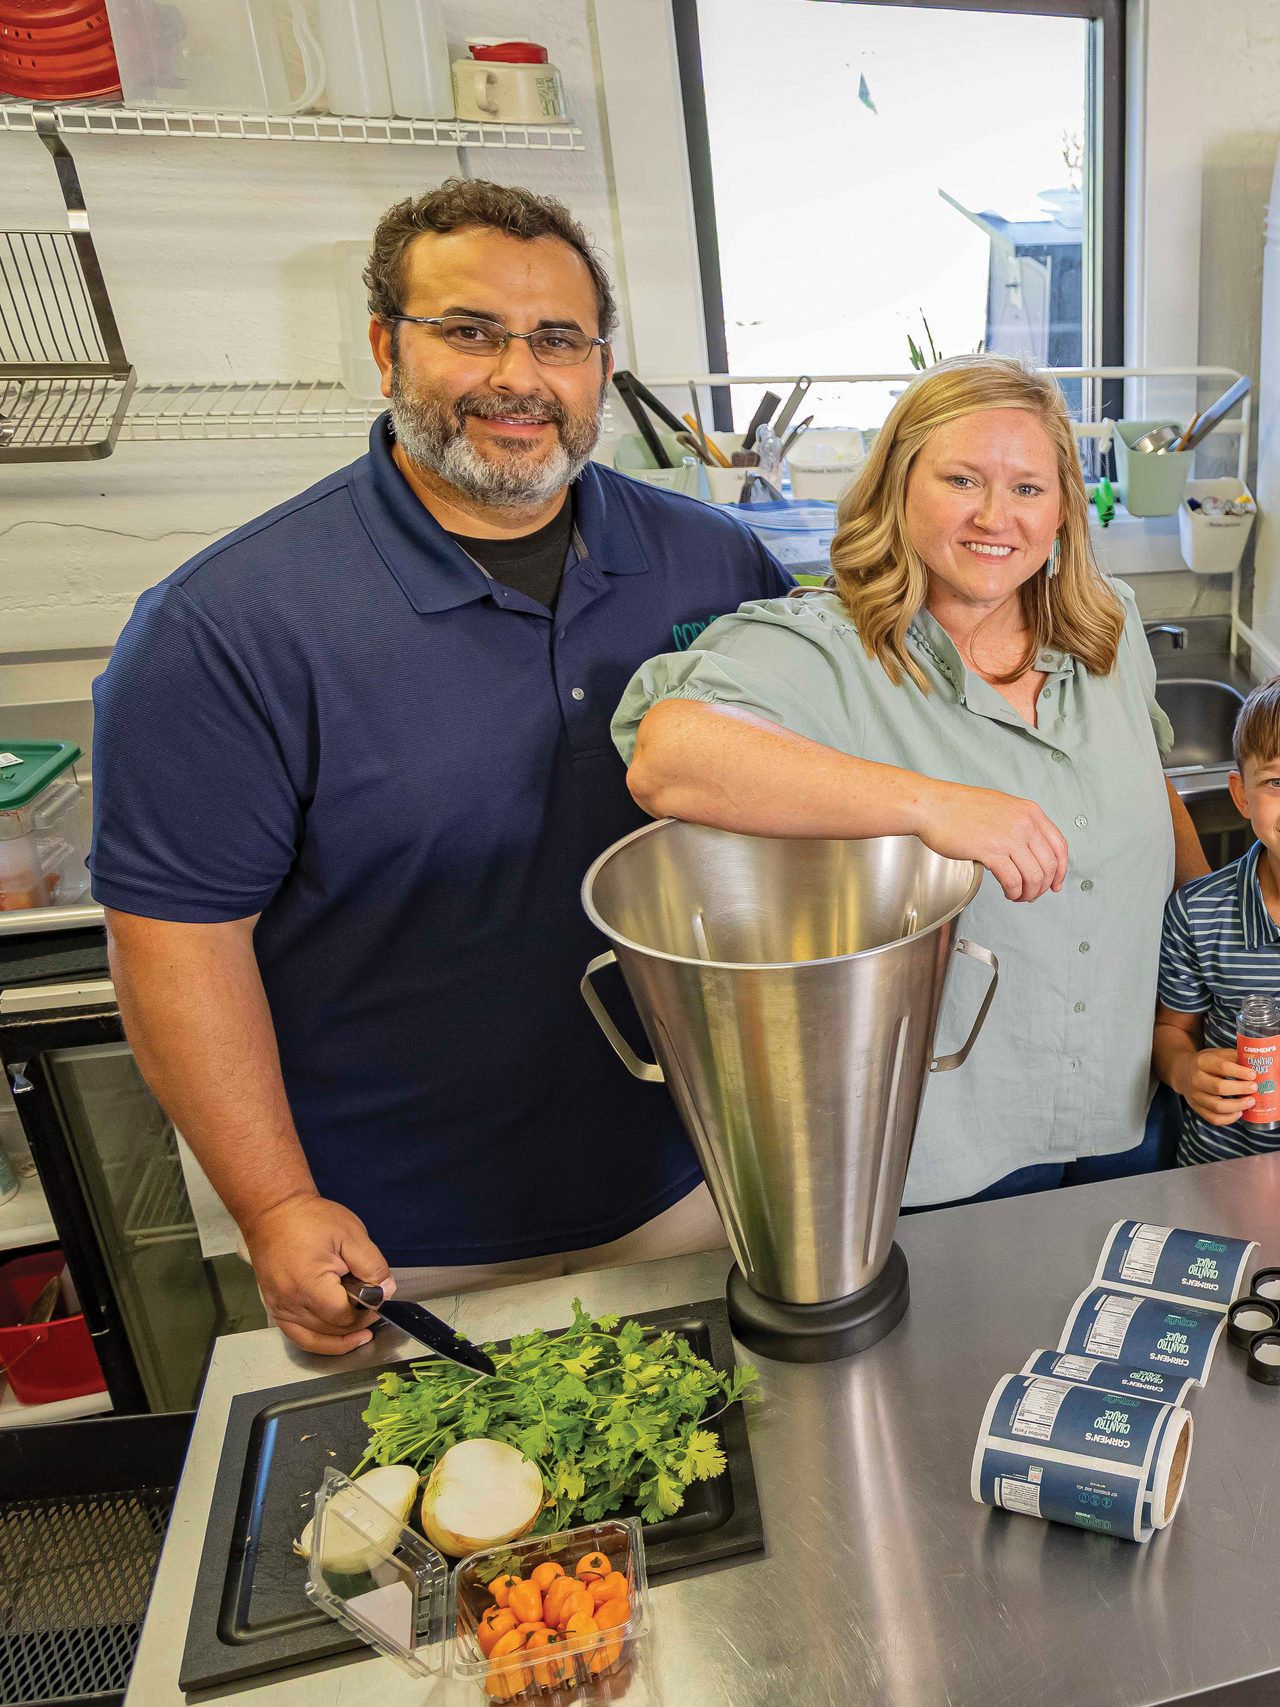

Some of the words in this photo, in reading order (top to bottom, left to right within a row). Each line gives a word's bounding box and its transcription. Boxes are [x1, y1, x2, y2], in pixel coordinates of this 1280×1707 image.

[1243, 1045, 1277, 1053] CARMEN'S
[1196, 1257, 1217, 1269] SAUCE
[1188, 1264, 1219, 1279] CILANTRO
[1181, 1278, 1219, 1291] CARMEN'S
[1166, 1331, 1187, 1343] SAUCE
[1156, 1338, 1189, 1354] CILANTRO
[1149, 1352, 1190, 1366] CARMEN'S
[1121, 1379, 1163, 1392] CARMEN'S
[1103, 1410, 1128, 1423] SAUCE
[1093, 1417, 1131, 1435] CILANTRO
[1028, 1430, 1049, 1439] Nutrition
[1085, 1432, 1131, 1448] CARMEN'S
